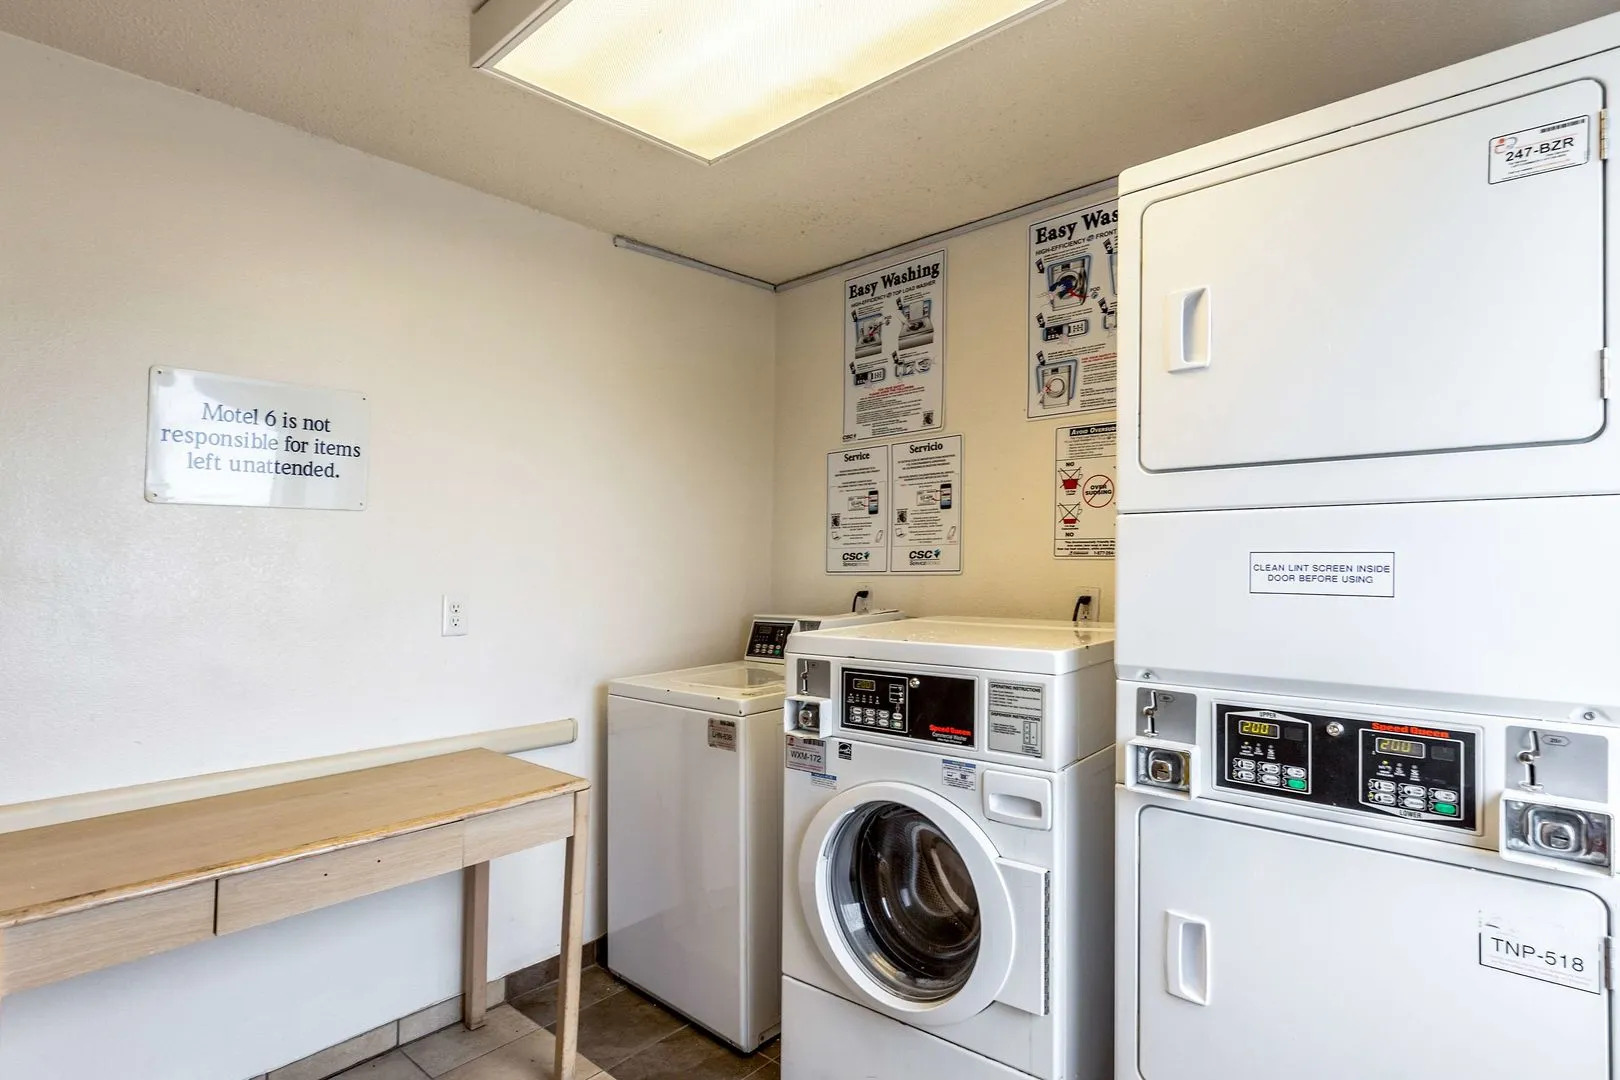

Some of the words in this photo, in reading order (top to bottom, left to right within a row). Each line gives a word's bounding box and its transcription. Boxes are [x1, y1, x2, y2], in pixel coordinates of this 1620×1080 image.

[1505, 137, 1574, 162] 247-BZR
[1035, 222, 1078, 245] Easy
[1035, 237, 1086, 256] HIGH-EFFICIENCY
[1095, 228, 1117, 239] FRONT
[849, 281, 880, 299] Easy
[881, 262, 941, 289] Washing
[201, 402, 259, 425] Motel
[264, 409, 277, 427] 6
[282, 411, 297, 429] is
[302, 416, 332, 433] not
[160, 427, 279, 451] responsible
[284, 436, 309, 453] for
[313, 438, 361, 458] items
[909, 442, 944, 455] Servicio
[844, 451, 871, 463] Service
[187, 451, 222, 471] left
[229, 458, 340, 479] unattended.
[842, 552, 863, 561] CSC
[909, 550, 933, 559] CSC
[1253, 564, 1285, 572] CLEAN
[1288, 564, 1310, 572] LINT
[1312, 564, 1353, 573] SCREEN
[1357, 565, 1391, 573] INSIDE
[1267, 574, 1296, 582] DOOR
[1298, 574, 1338, 583] BEFORE
[1342, 575, 1374, 584] USING
[1012, 685, 1041, 694] INSTRUCTIONS
[1012, 714, 1041, 722] INSTRUCTIONS
[1259, 711, 1277, 719] UPPER
[1371, 721, 1409, 733] Speed
[1409, 726, 1450, 738] Queen
[790, 750, 822, 763] WXM-172
[1399, 809, 1422, 818] LOWER
[1491, 936, 1585, 973] TNP-518
